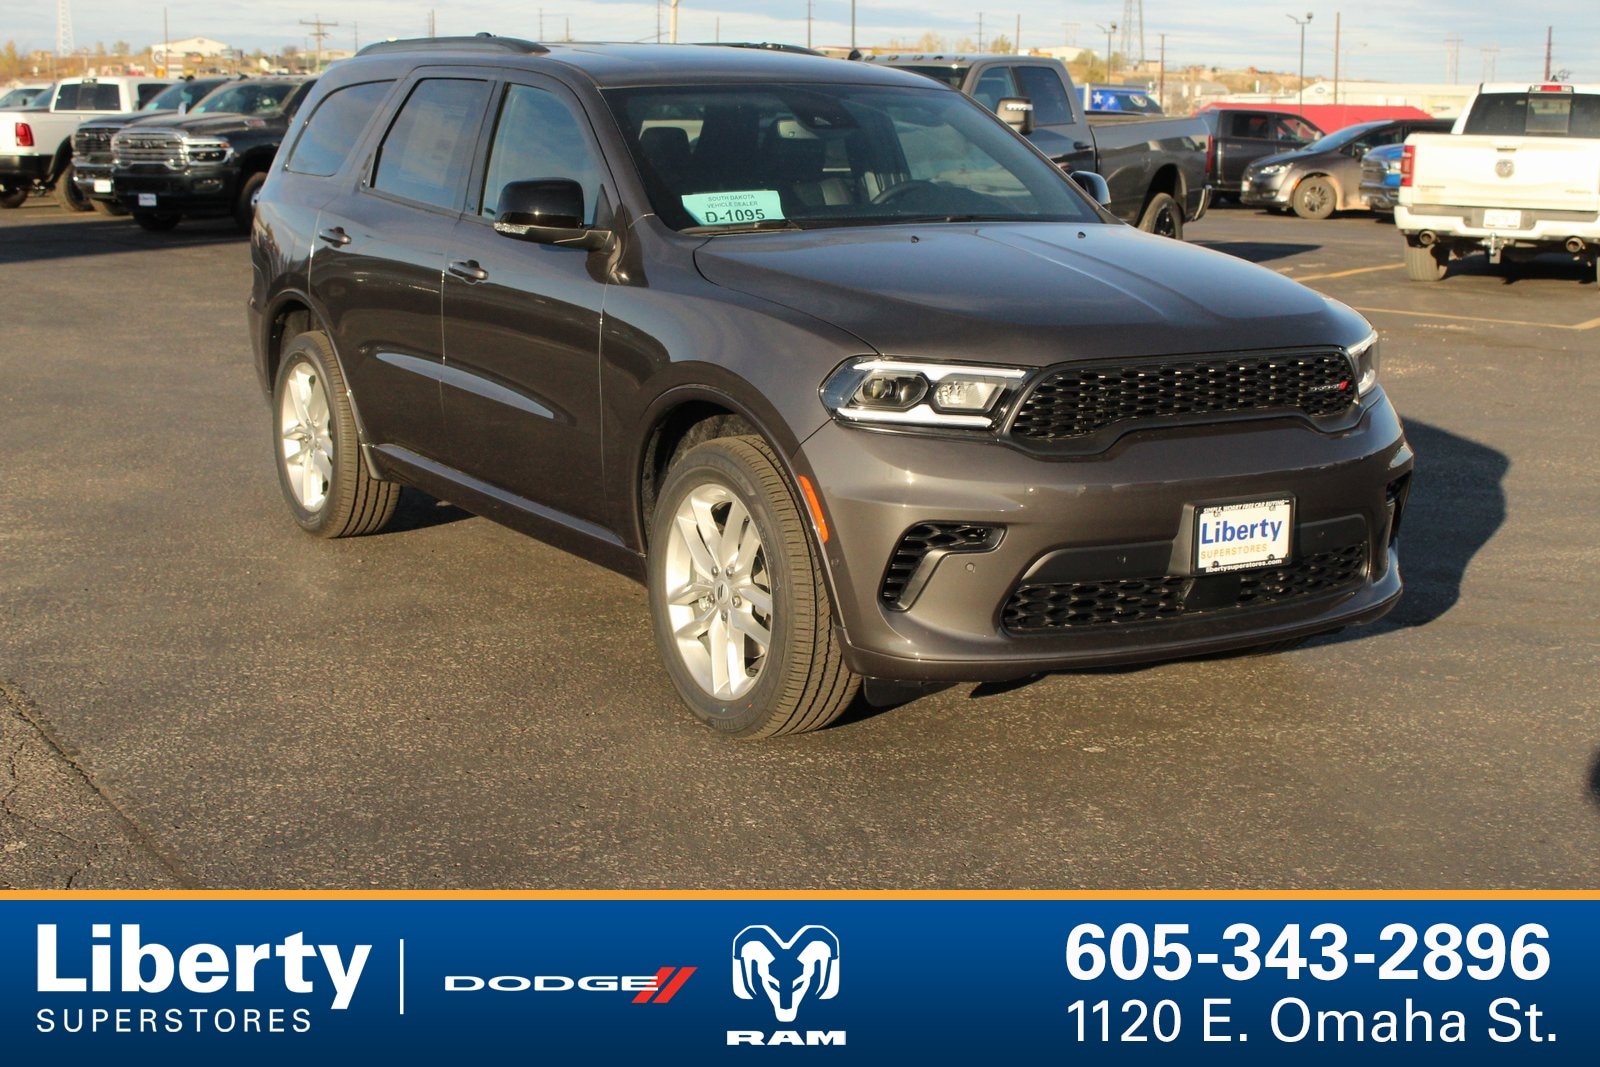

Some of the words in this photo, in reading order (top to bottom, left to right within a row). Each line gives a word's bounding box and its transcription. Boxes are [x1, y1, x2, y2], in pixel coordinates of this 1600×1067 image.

[705, 208, 765, 223] D-1095
[1201, 518, 1282, 545] Liberty
[1200, 543, 1268, 560] SUPERSTORES
